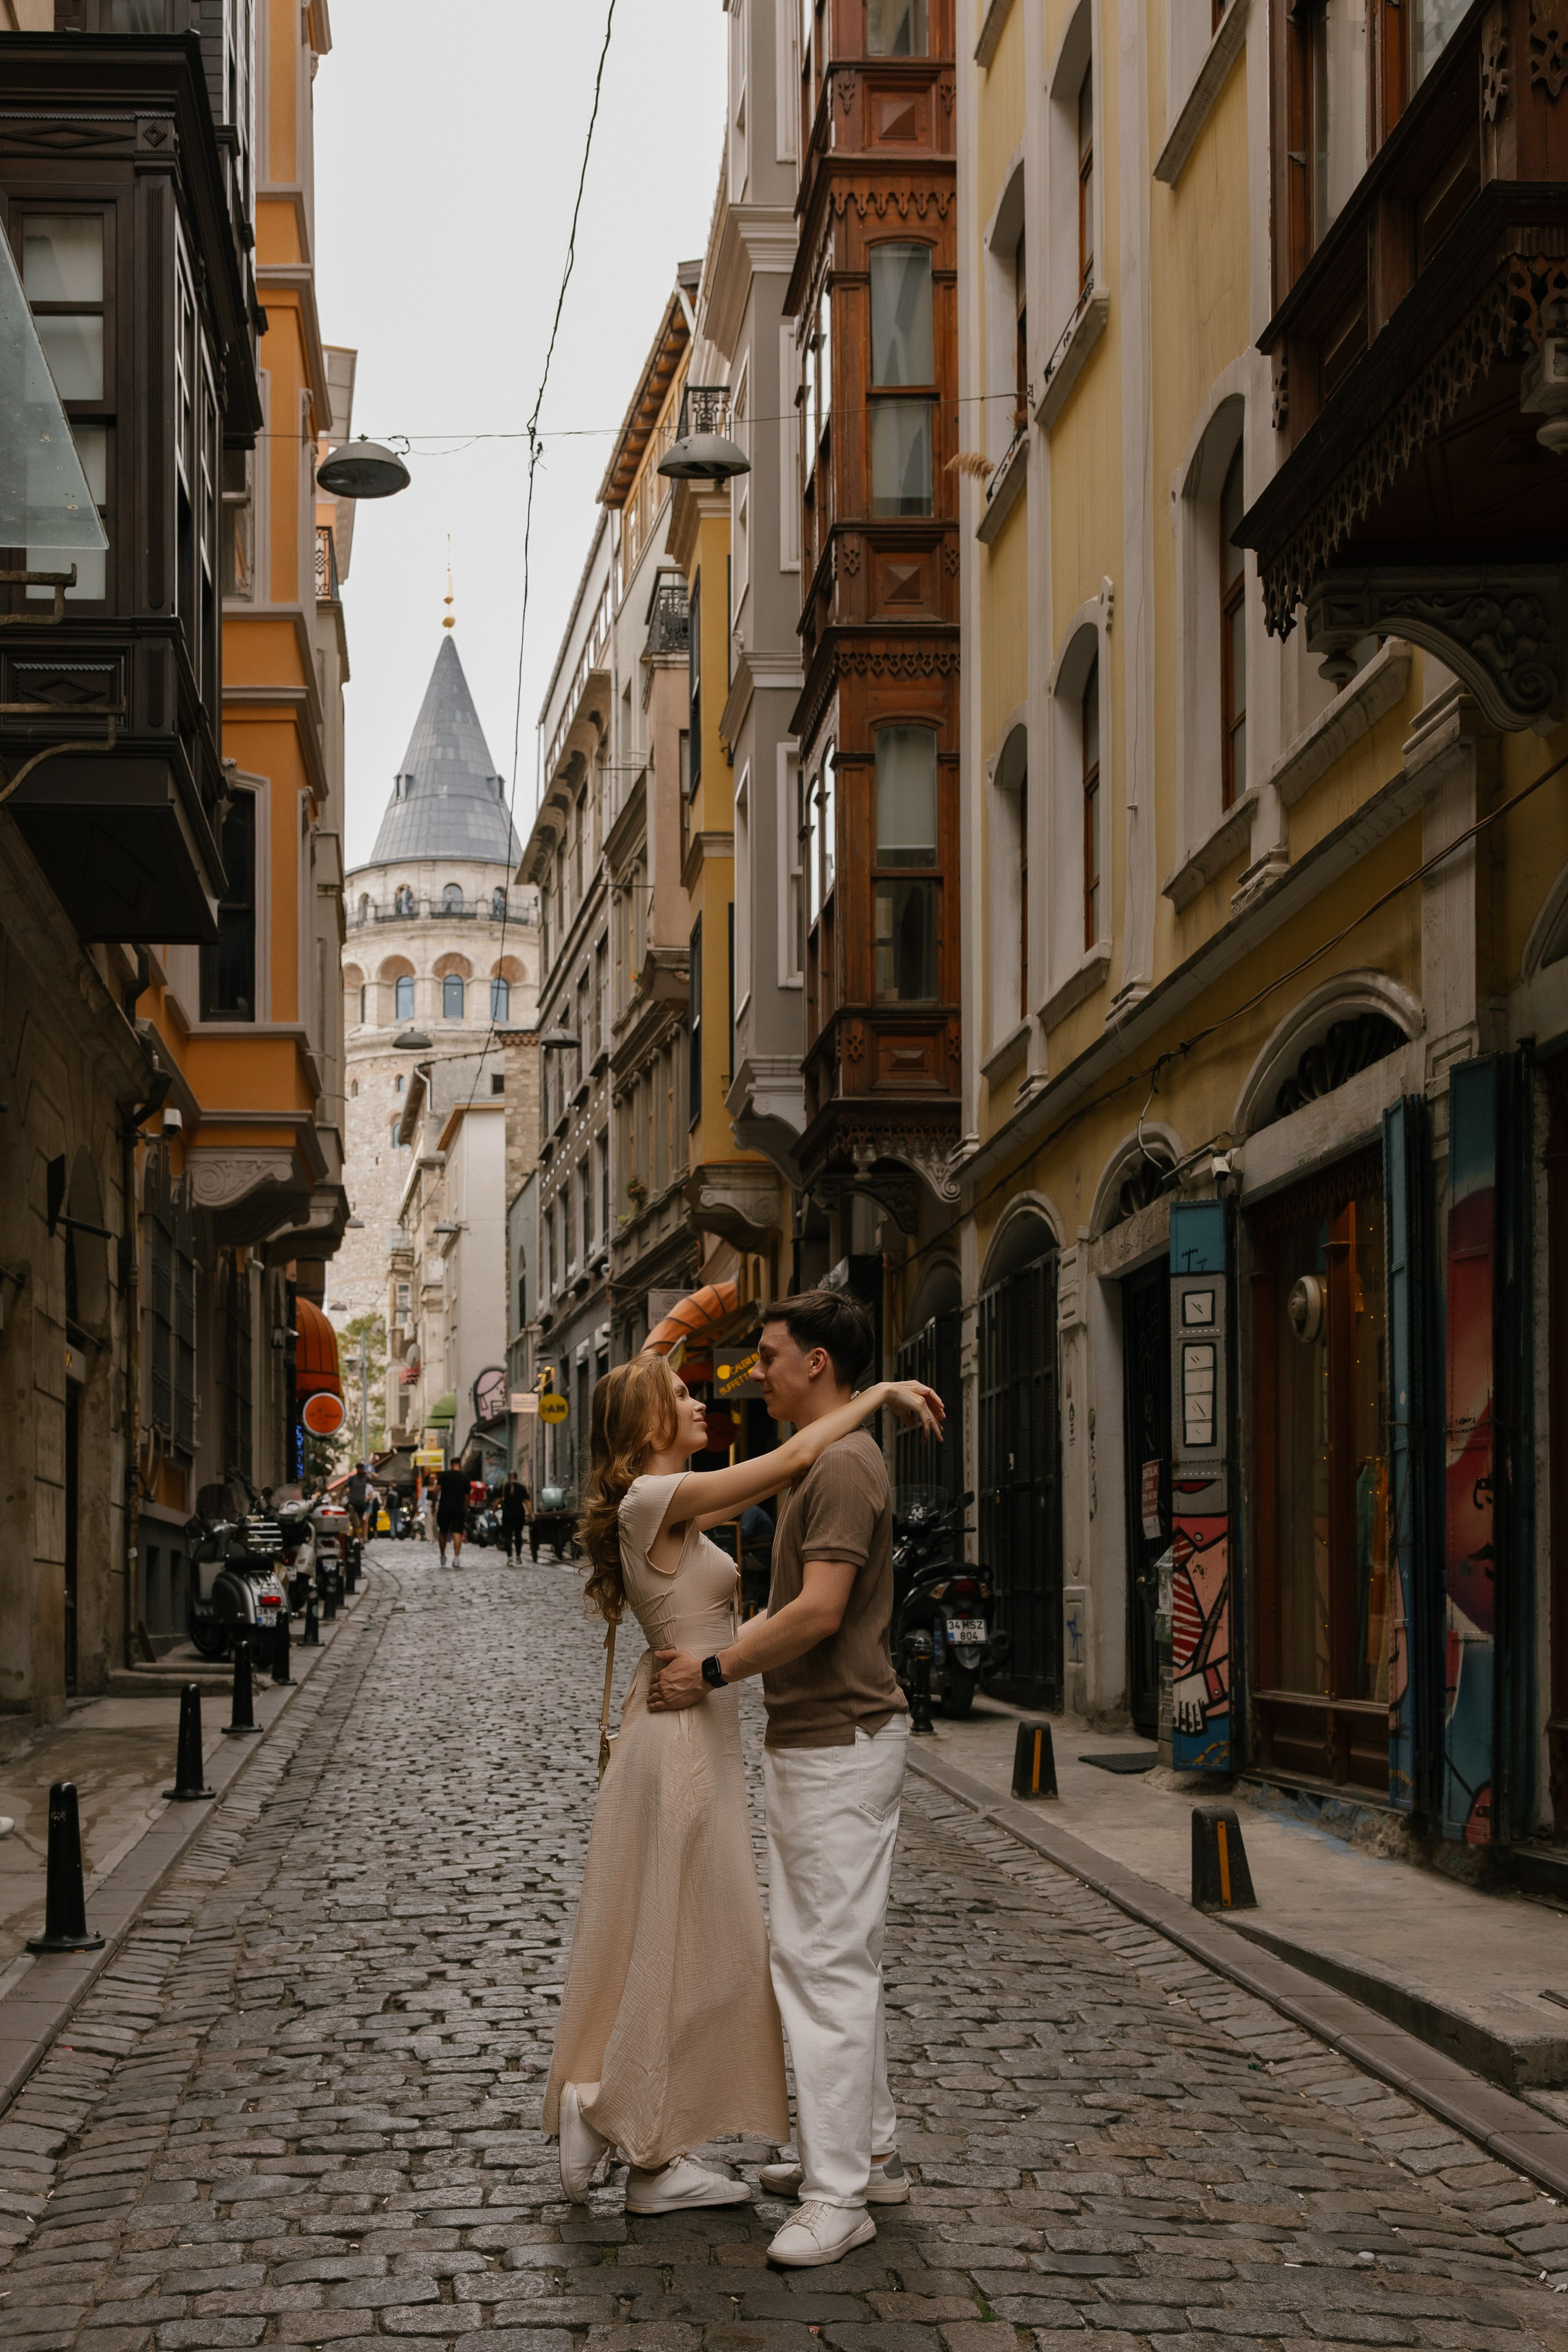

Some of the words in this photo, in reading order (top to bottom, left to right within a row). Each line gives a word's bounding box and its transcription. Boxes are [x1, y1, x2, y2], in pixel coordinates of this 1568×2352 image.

[948, 1621, 960, 1629] 34
[962, 1621, 983, 1629] MSZ
[960, 1632, 978, 1640] 804
